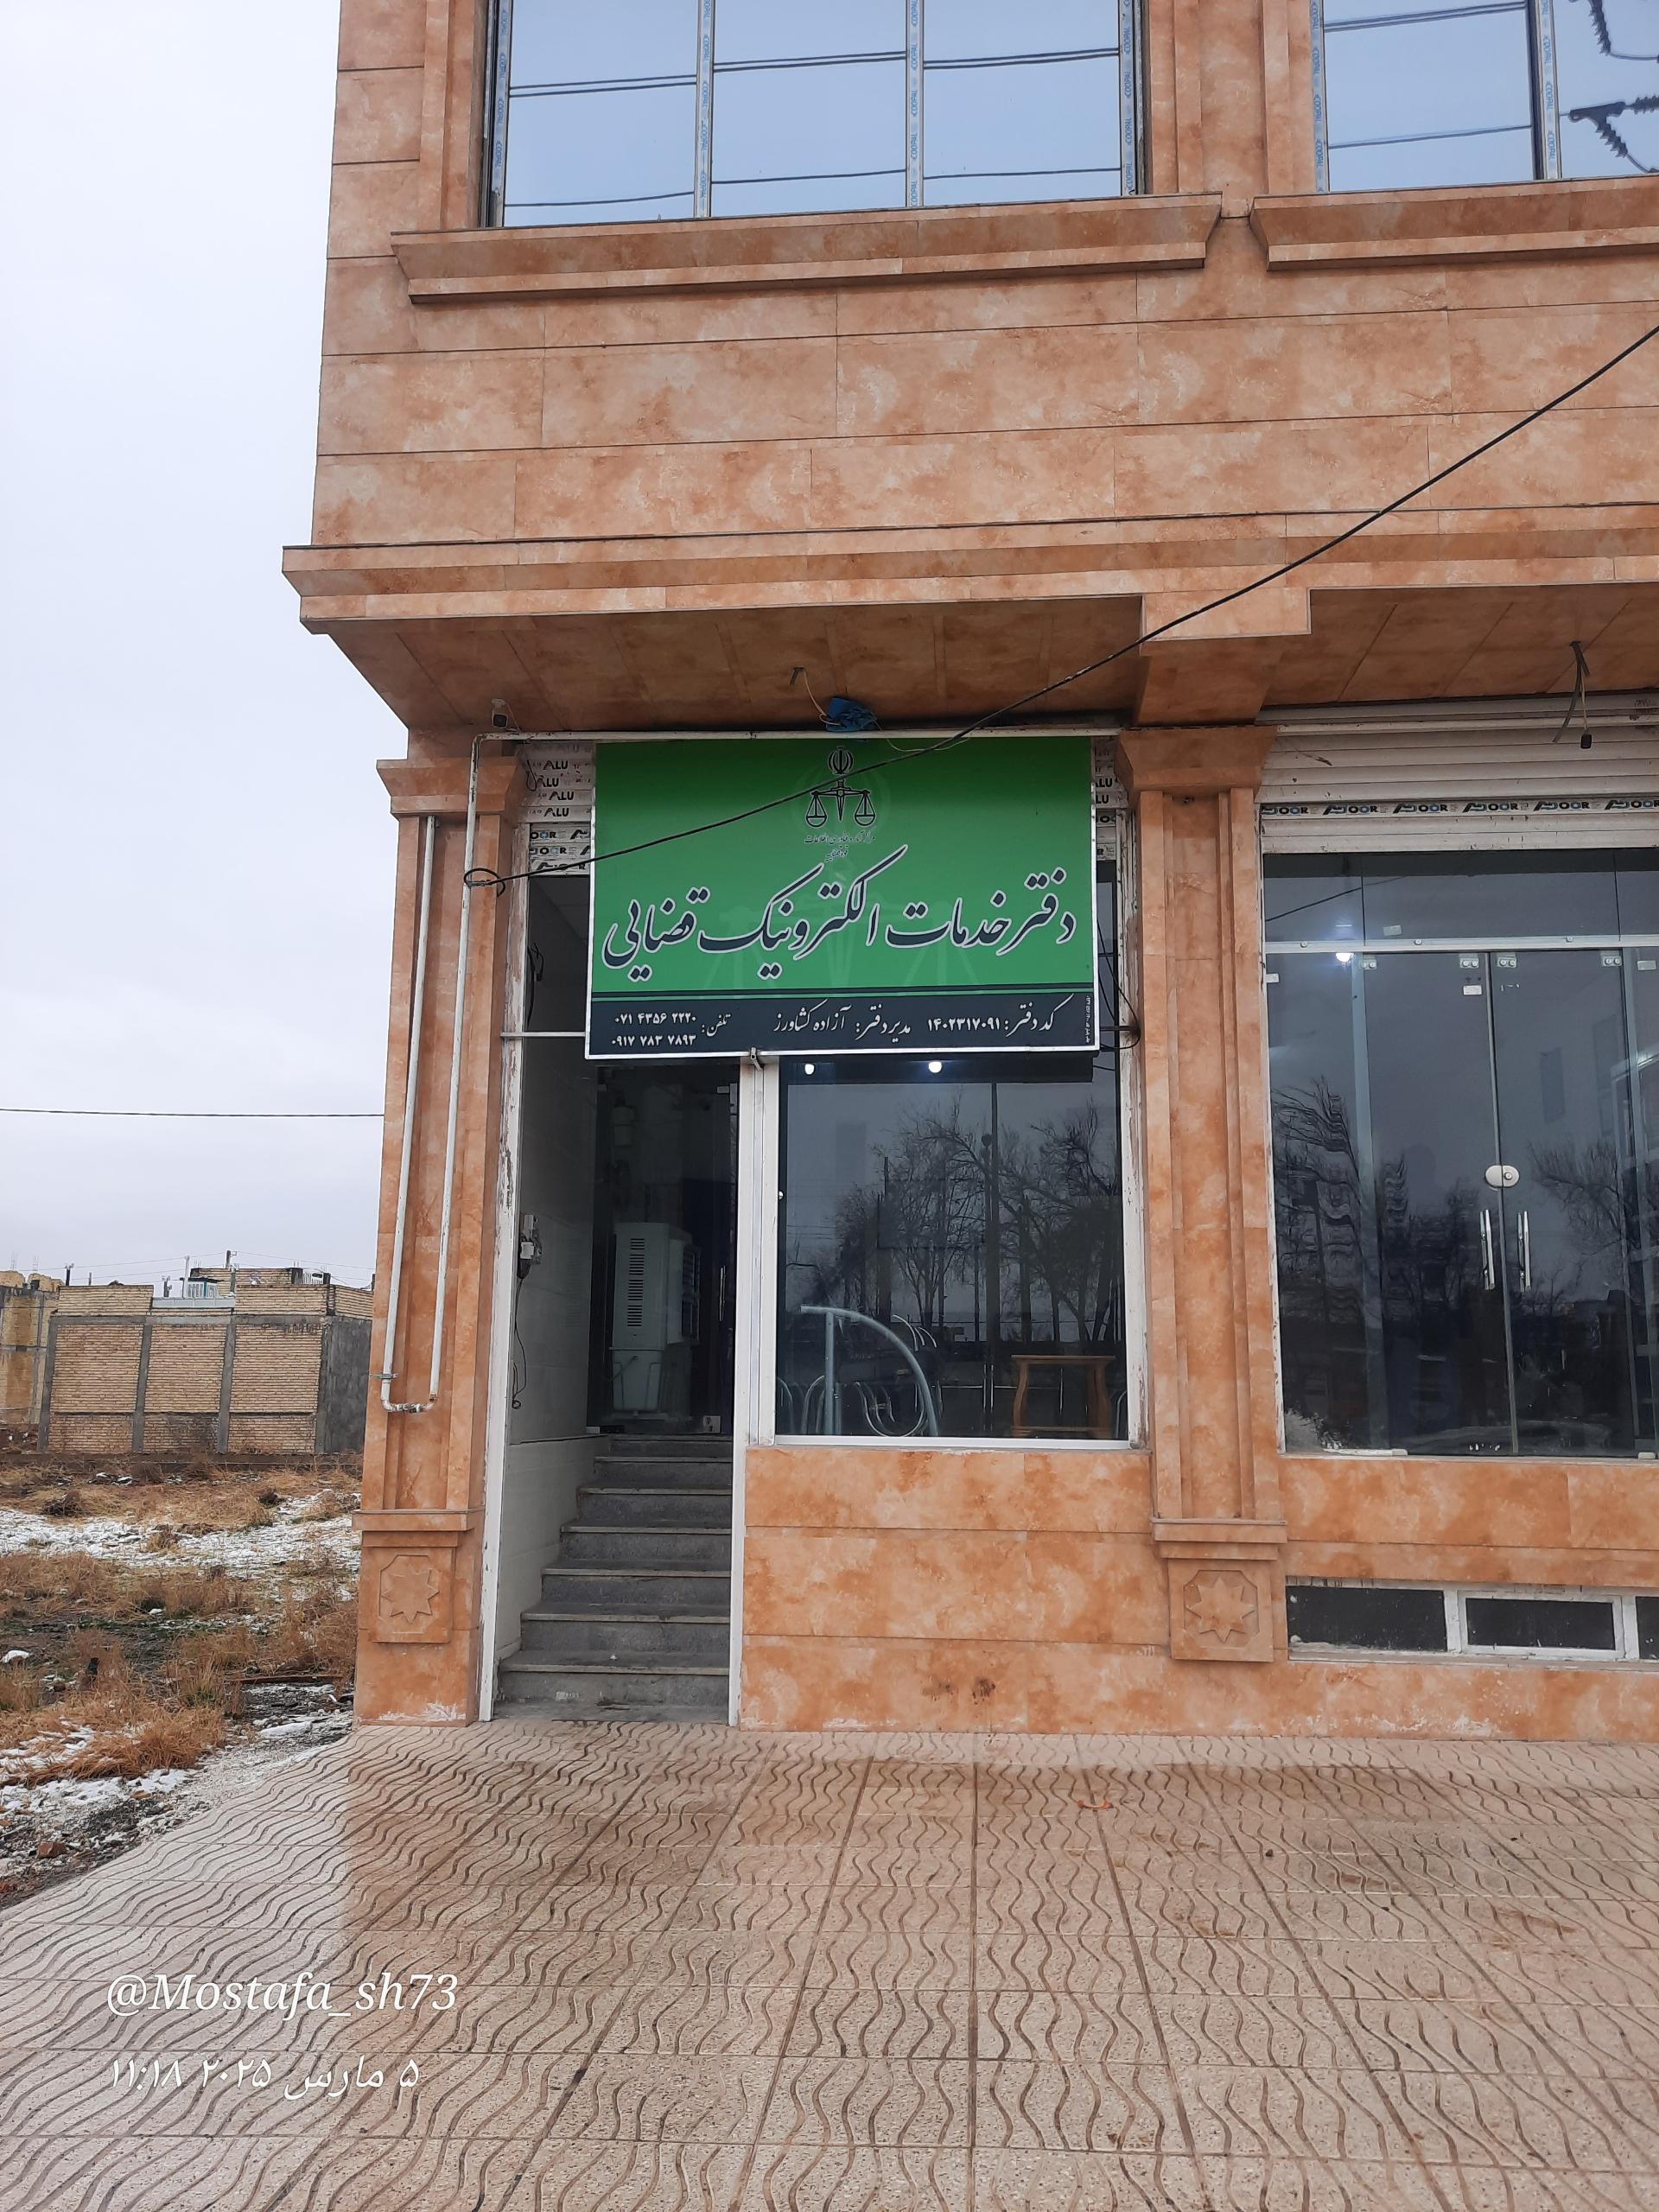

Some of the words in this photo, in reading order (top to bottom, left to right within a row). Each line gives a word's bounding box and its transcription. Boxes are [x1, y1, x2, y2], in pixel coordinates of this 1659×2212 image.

[543, 808, 569, 817] ALU
[696, 843, 909, 981] الکترونیک
[885, 890, 1014, 950] خدمات
[995, 866, 1077, 957] دفتر
[602, 886, 711, 982] قضایی
[614, 1013, 633, 1025] ۰۷۱
[637, 1013, 667, 1025] ۴۳۵۶
[773, 999, 829, 1032] کشاورز
[813, 1005, 852, 1032] آزاده
[927, 1016, 1001, 1032] ۱۴۰۲۳۱۷۰۹۱
[1039, 993, 1075, 1031] کد
[611, 1035, 636, 1047] ۰۹۱۷
[639, 1035, 663, 1047] ۷۸۳
[667, 1034, 696, 1046] ۷۸۹۳
[887, 1020, 912, 1043] مدیر
